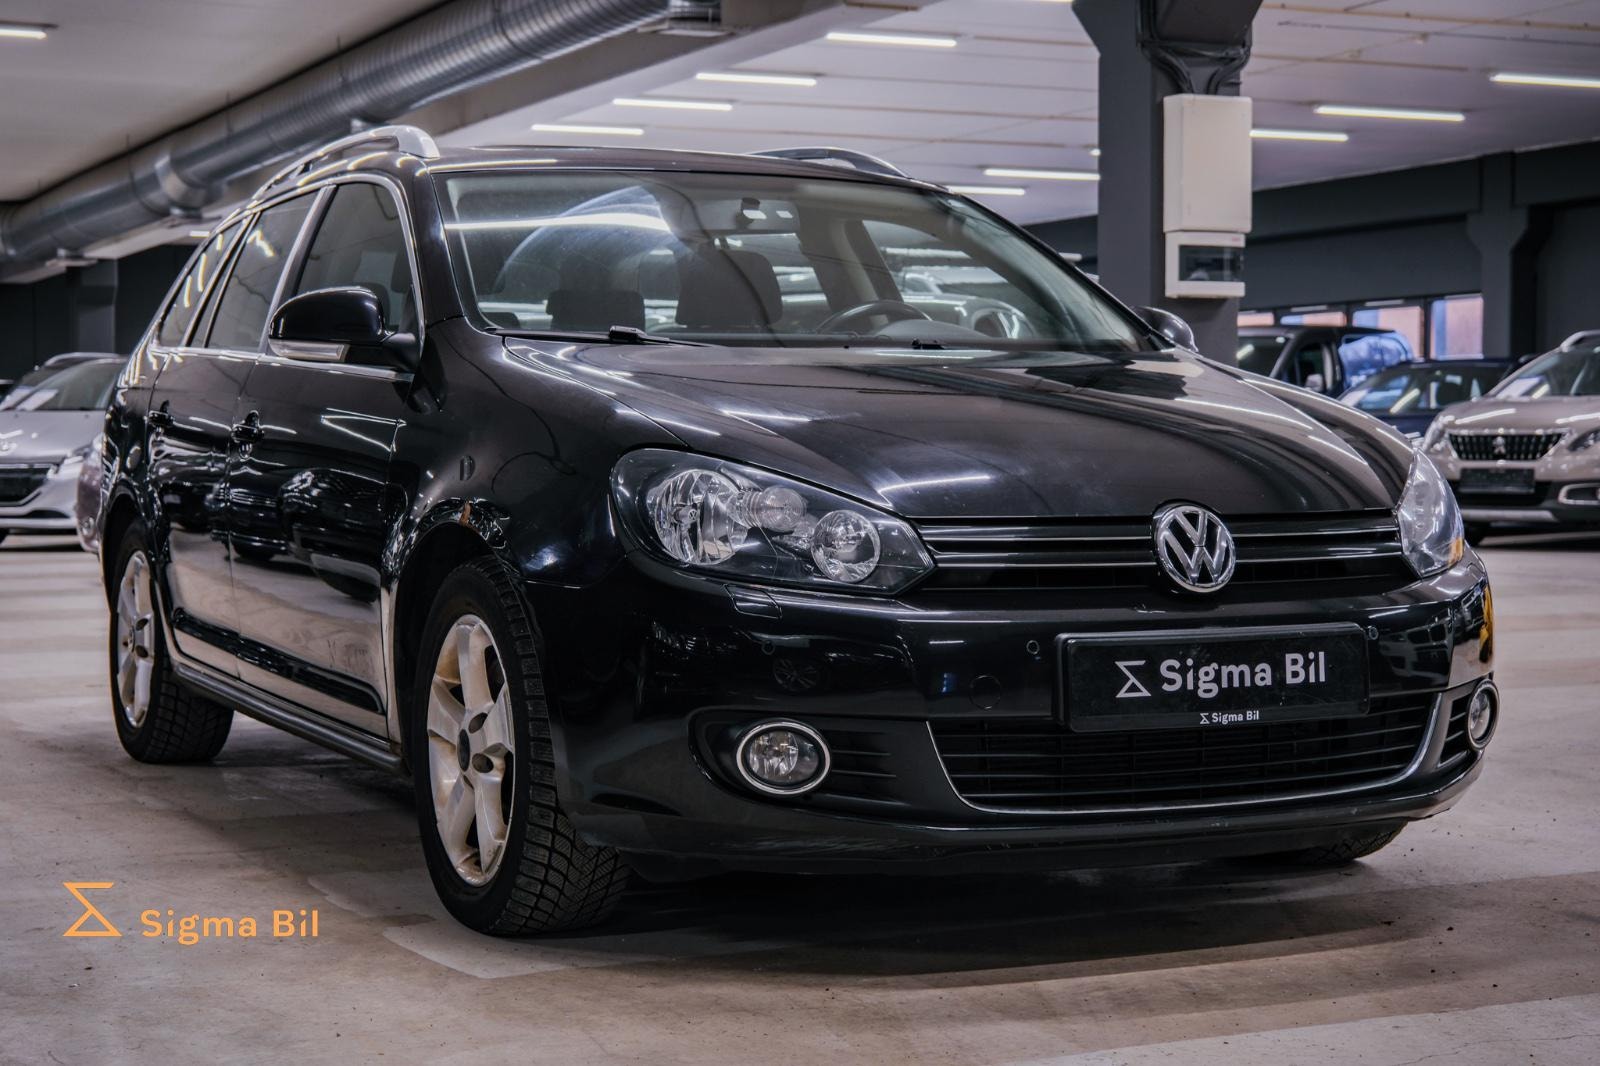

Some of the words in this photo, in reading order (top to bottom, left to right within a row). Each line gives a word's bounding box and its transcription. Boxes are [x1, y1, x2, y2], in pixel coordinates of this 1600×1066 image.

[1160, 658, 1272, 698] Sigma
[1286, 651, 1326, 684] Bil
[1211, 712, 1244, 724] Sigma
[1246, 710, 1259, 720] Bil
